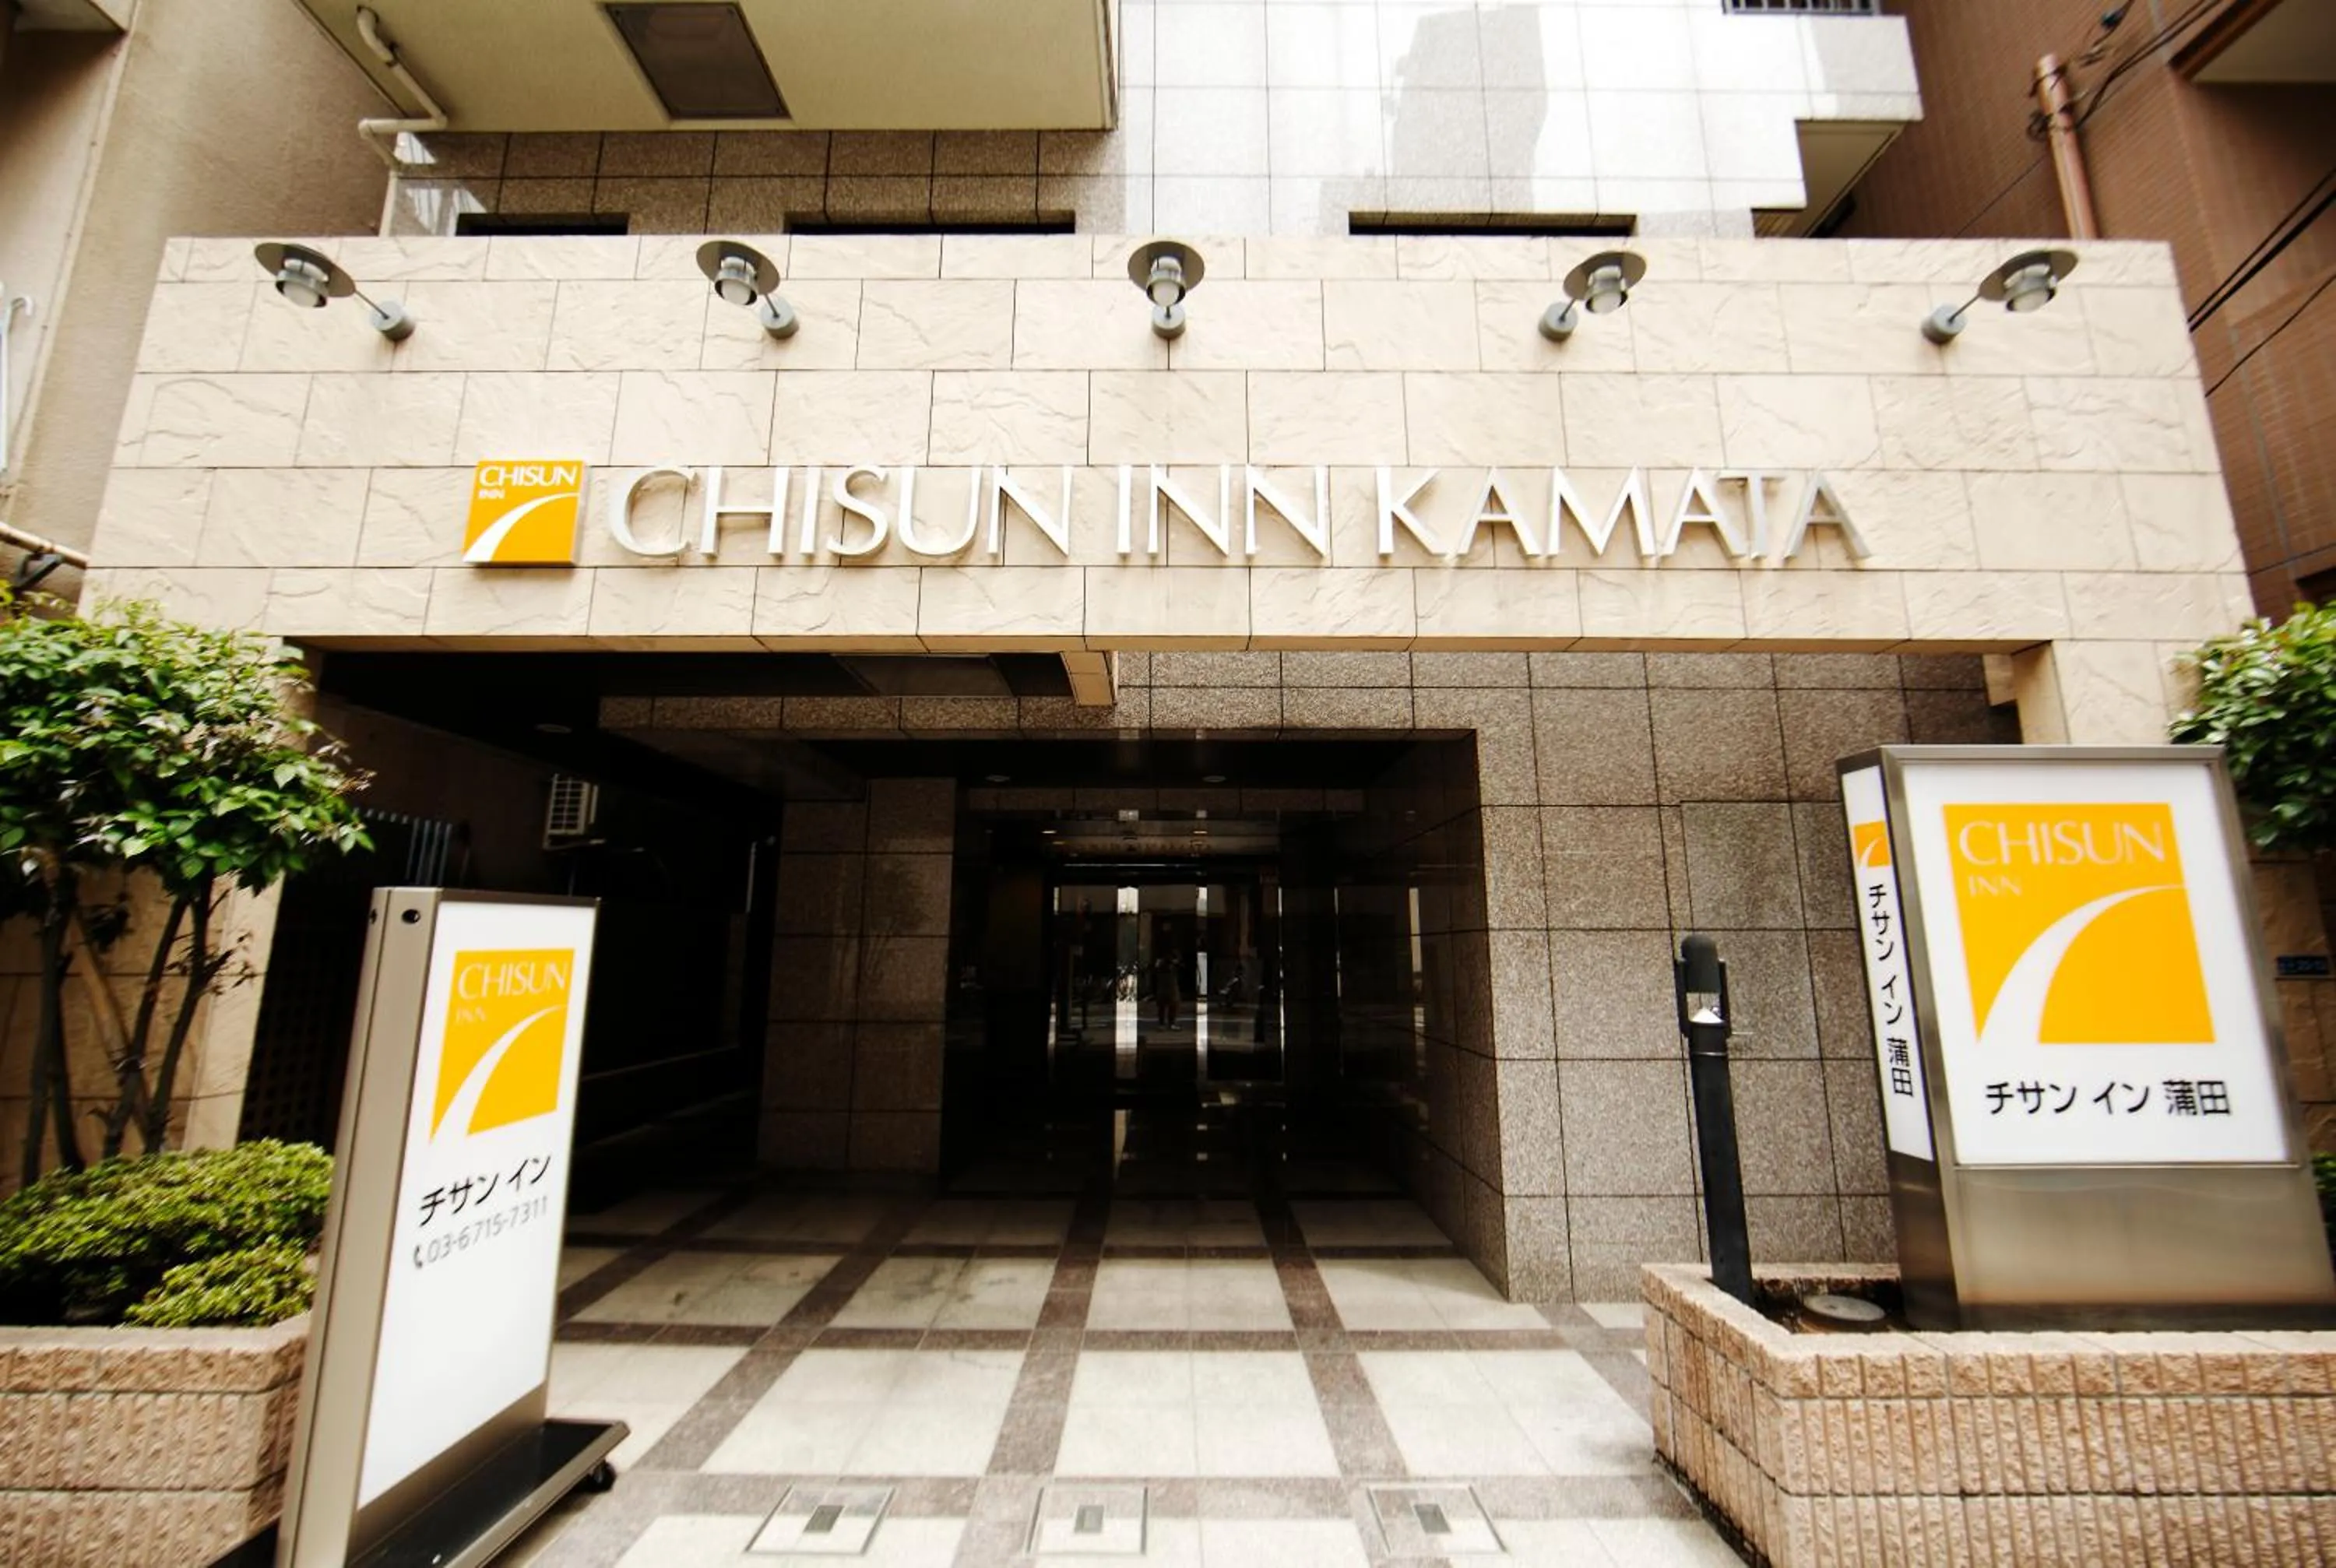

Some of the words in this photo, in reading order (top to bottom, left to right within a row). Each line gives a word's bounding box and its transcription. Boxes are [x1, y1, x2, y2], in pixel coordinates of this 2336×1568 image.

[479, 466, 578, 487] CHISUN
[608, 465, 1072, 559] CHISUN
[1116, 465, 1331, 557] INN
[1375, 465, 1873, 559] KAMATA
[1958, 820, 2165, 866] CHISUN
[1968, 874, 2023, 897] INN
[1869, 884, 1894, 961] チサン
[458, 961, 568, 1000] CHISUN
[1881, 975, 1902, 1025] イン
[1887, 1038, 1913, 1098] 蒲田
[1986, 1081, 2077, 1114] チサン
[2093, 1081, 2150, 1114] イン
[2162, 1080, 2231, 1116] 蒲田
[419, 1172, 500, 1228] チサン
[506, 1155, 551, 1192] イン
[427, 1195, 548, 1263] 03-6715-7311
